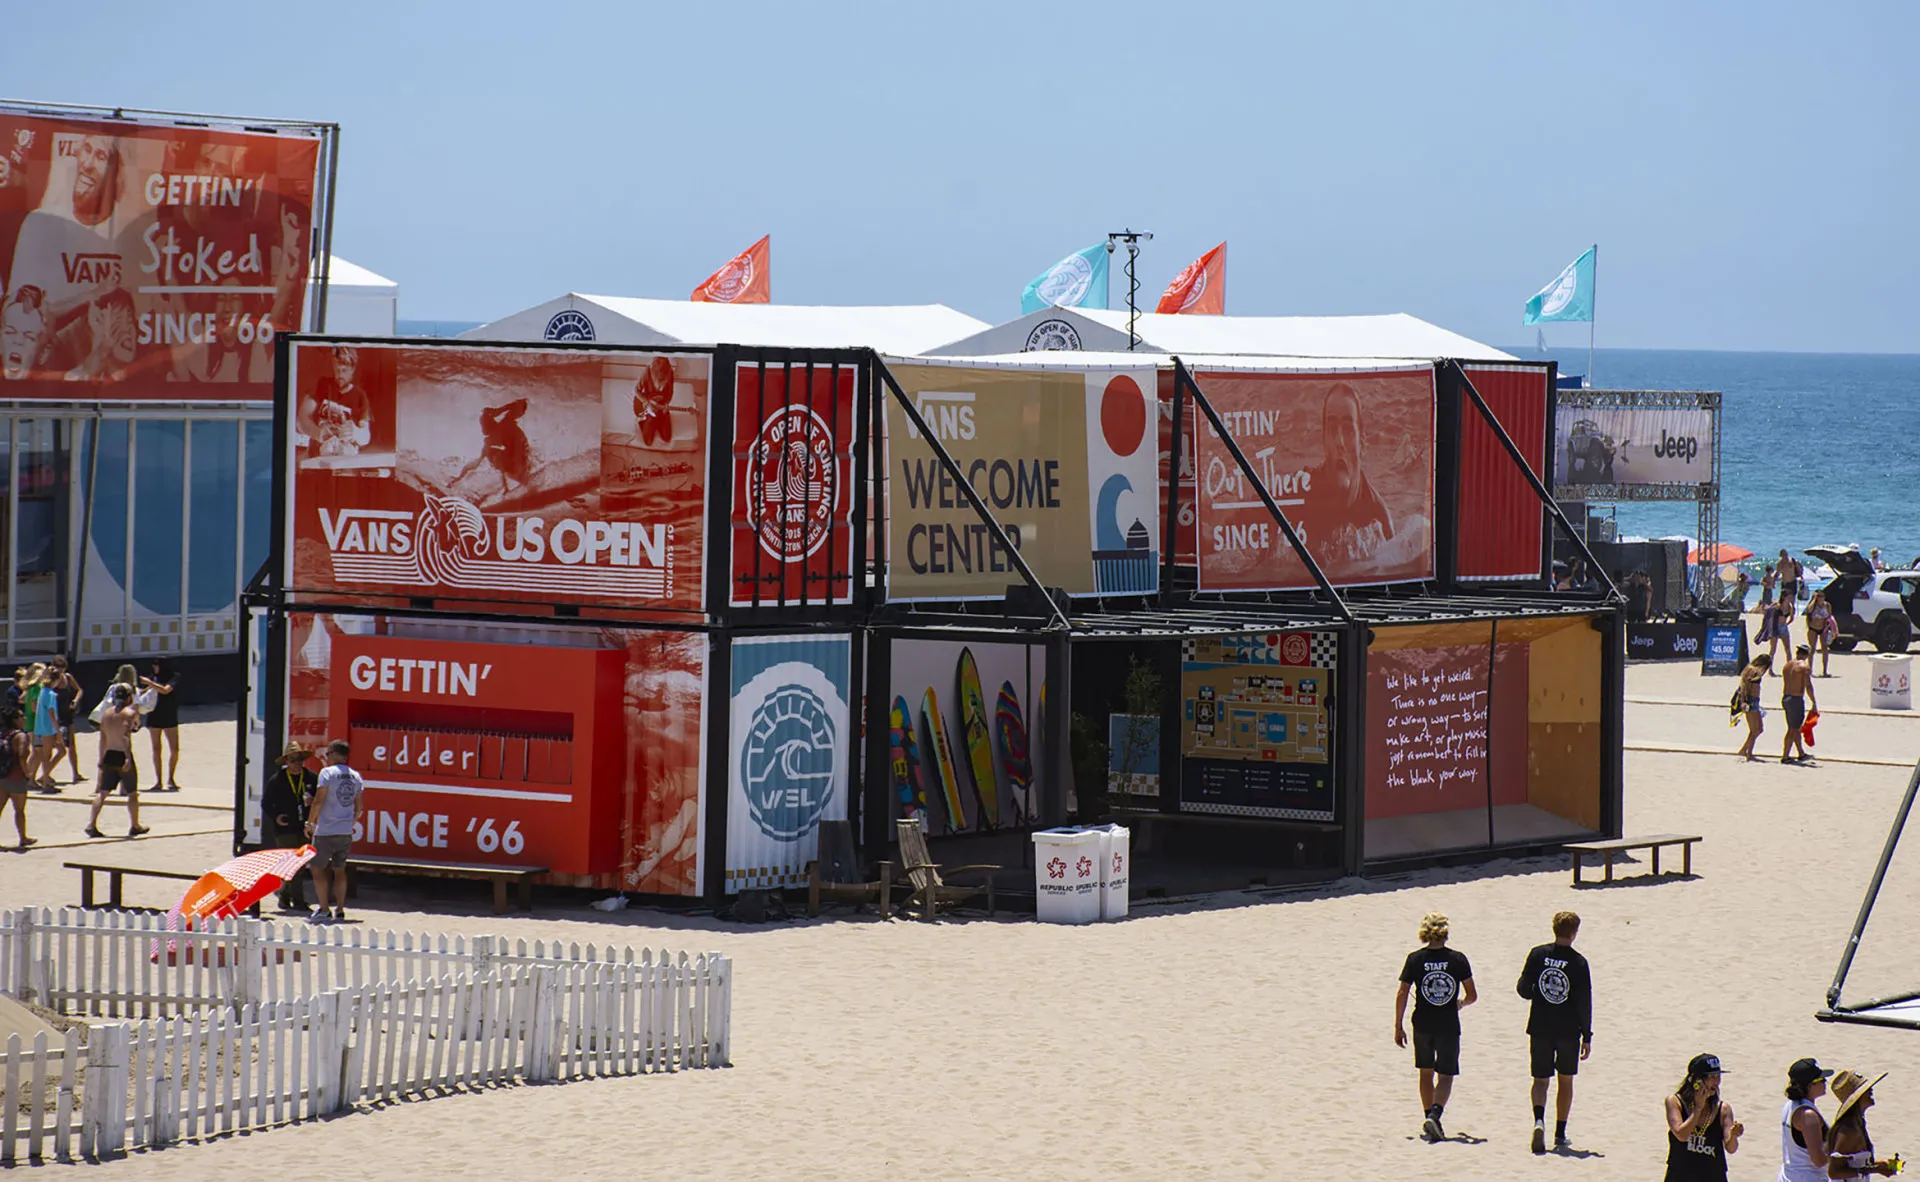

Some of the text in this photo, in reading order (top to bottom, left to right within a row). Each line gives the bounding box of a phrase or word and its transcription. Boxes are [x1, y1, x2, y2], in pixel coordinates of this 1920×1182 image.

[145, 173, 253, 207] GETTIN'
[139, 222, 260, 284] Stoked
[61, 253, 122, 284] VANS
[137, 312, 275, 345] SINCE '66
[771, 415, 802, 443] OPEN
[1654, 429, 1697, 464] Jeep
[902, 459, 1061, 509] WELCOME
[1207, 457, 1245, 499] Out
[318, 508, 665, 567] VANS US OPEN
[1213, 523, 1270, 551] SINCE
[1630, 634, 1698, 654] Jeep Jeep
[349, 655, 492, 697] GETTIN'
[1432, 669, 1444, 692] get
[1448, 668, 1473, 684] weird.
[1418, 698, 1424, 706] is
[1387, 717, 1397, 728] or
[1436, 736, 1444, 744] or
[1386, 773, 1405, 788] the
[465, 817, 525, 856] '66
[1040, 884, 1074, 892] REPUBLIC
[1423, 961, 1449, 971] STAFF
[1543, 957, 1569, 969] STAFF
